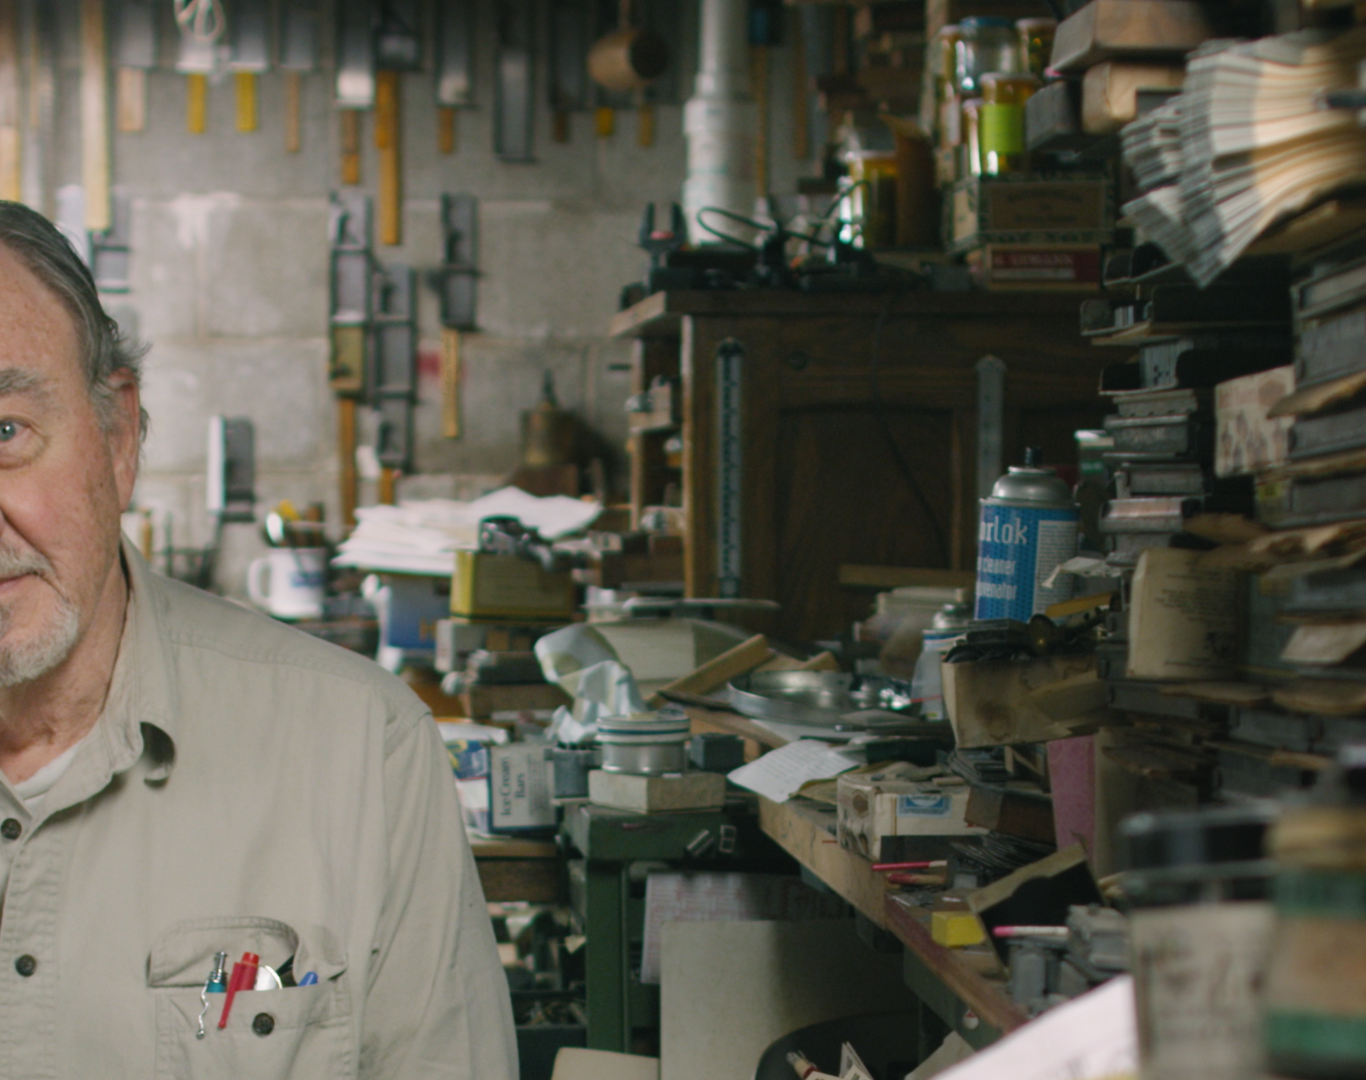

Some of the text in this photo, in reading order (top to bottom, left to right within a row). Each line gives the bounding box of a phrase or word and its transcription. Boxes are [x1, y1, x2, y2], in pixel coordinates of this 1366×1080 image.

[499, 756, 511, 816] Ice Cream
[514, 772, 526, 797] Bars
